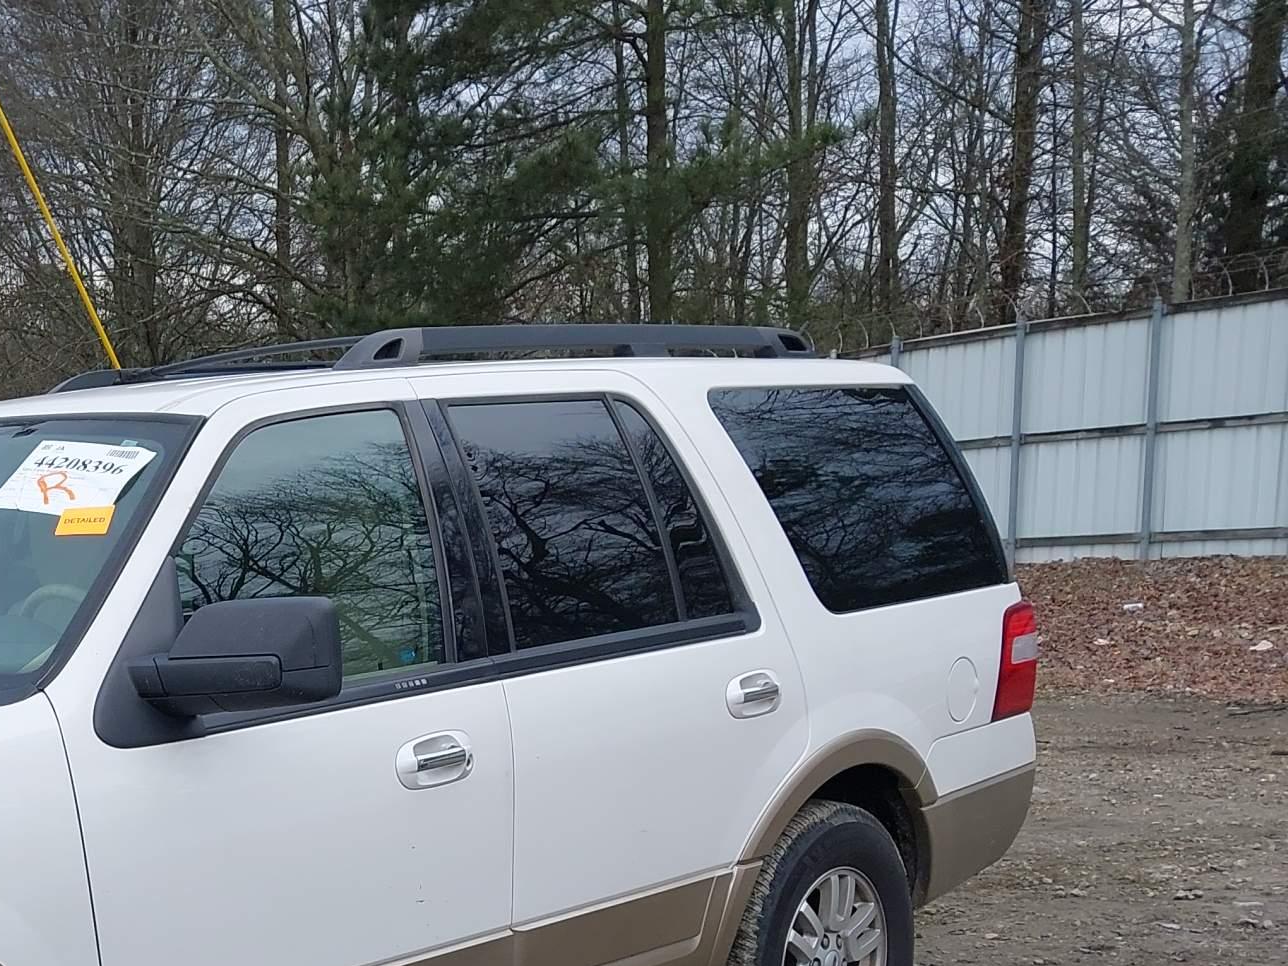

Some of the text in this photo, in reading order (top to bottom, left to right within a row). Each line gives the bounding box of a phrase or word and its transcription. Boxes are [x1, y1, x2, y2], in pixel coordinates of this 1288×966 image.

[34, 455, 128, 475] 44208396
[37, 471, 76, 505] R
[63, 516, 106, 525] DETAILED
